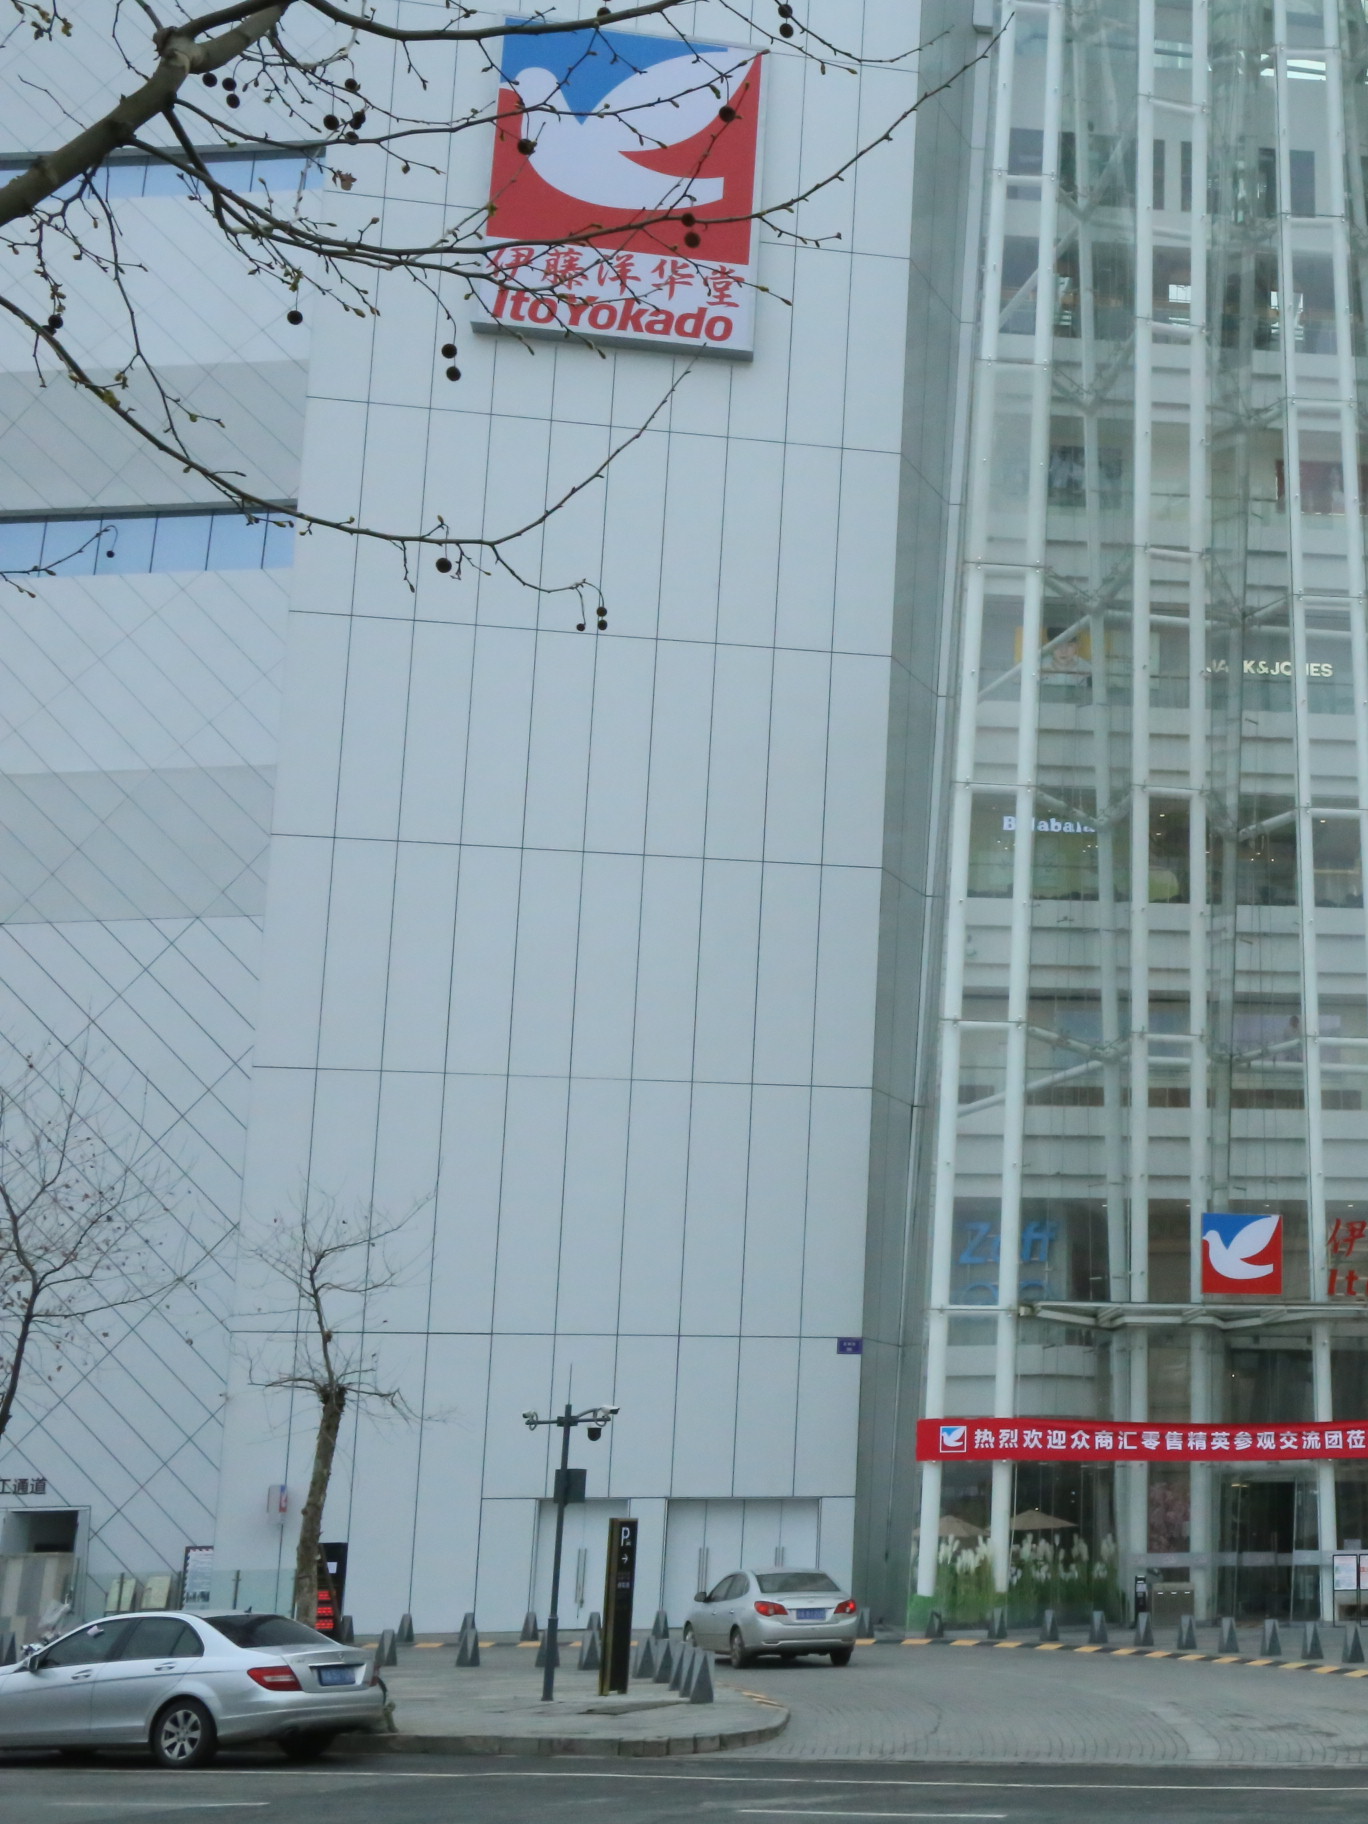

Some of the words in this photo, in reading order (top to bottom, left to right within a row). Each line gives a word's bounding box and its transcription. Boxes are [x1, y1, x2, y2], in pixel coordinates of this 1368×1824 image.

[485, 247, 745, 308] 伊藤洋华堂
